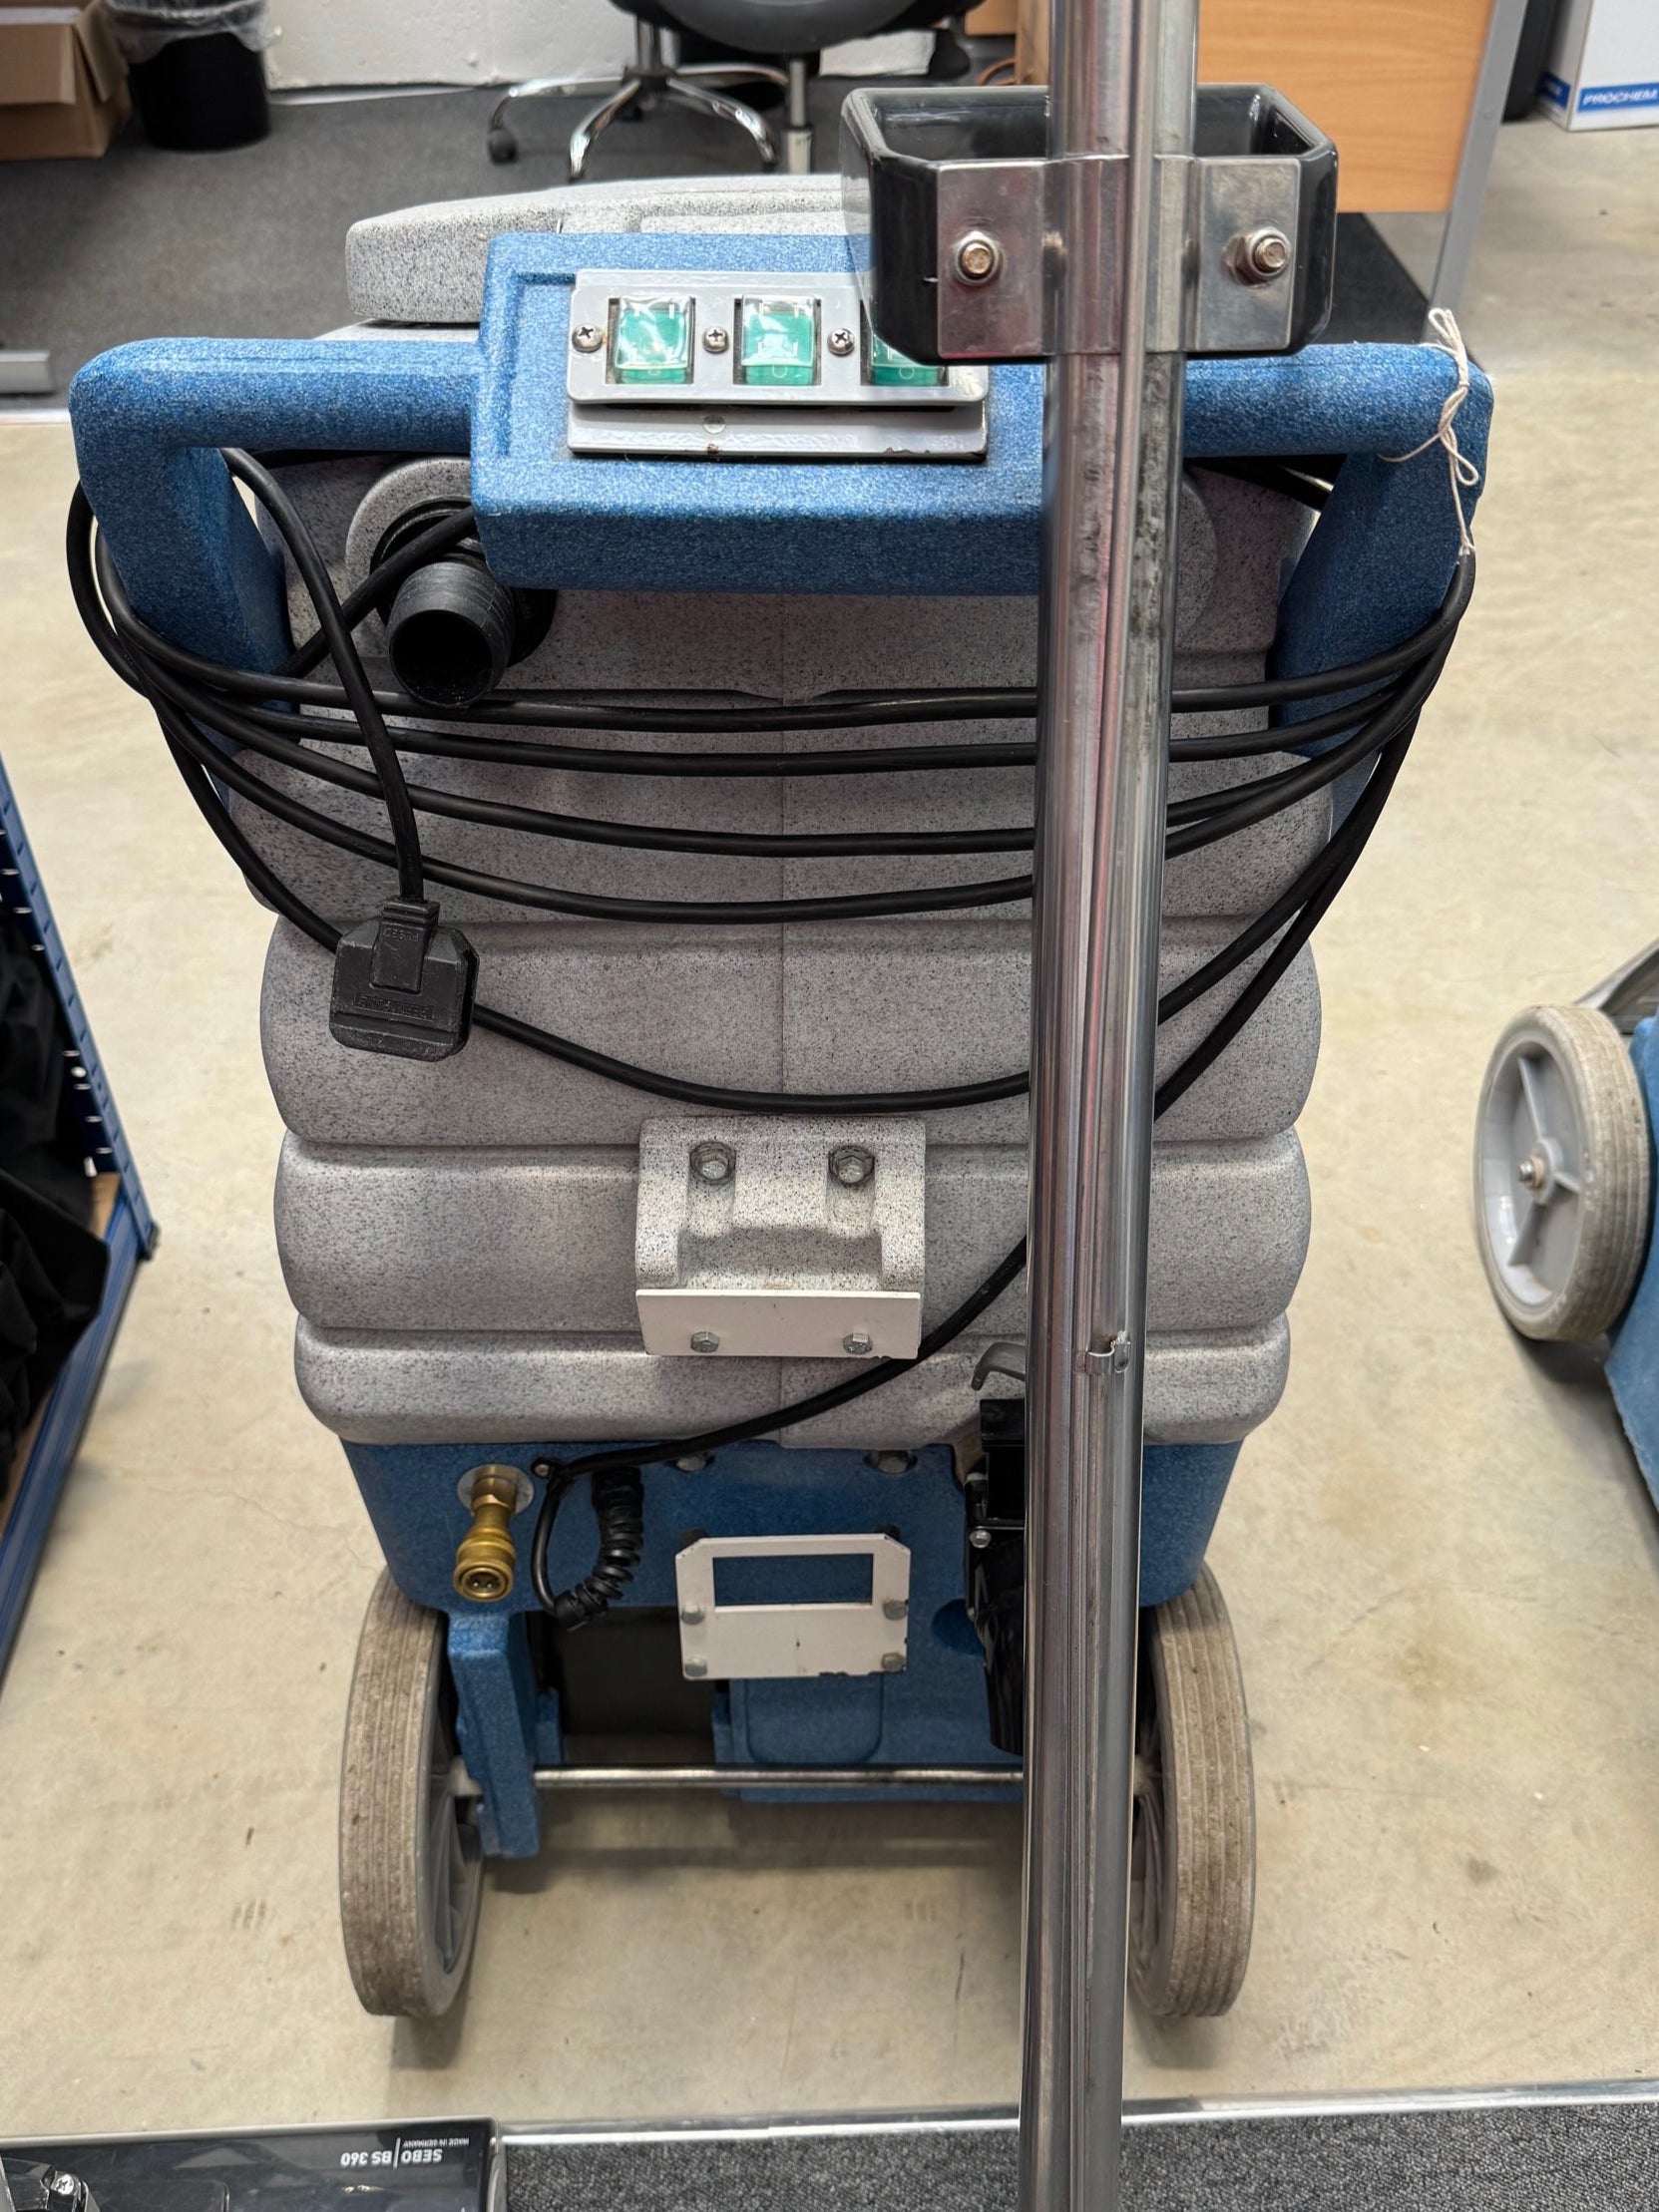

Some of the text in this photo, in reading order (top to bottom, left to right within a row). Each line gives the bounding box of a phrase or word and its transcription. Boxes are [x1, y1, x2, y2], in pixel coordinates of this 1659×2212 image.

[1583, 89, 1658, 106] PROCHEM
[402, 2137, 470, 2148] MADE IN GERMANY
[340, 2148, 443, 2166] SEBO BS 360
